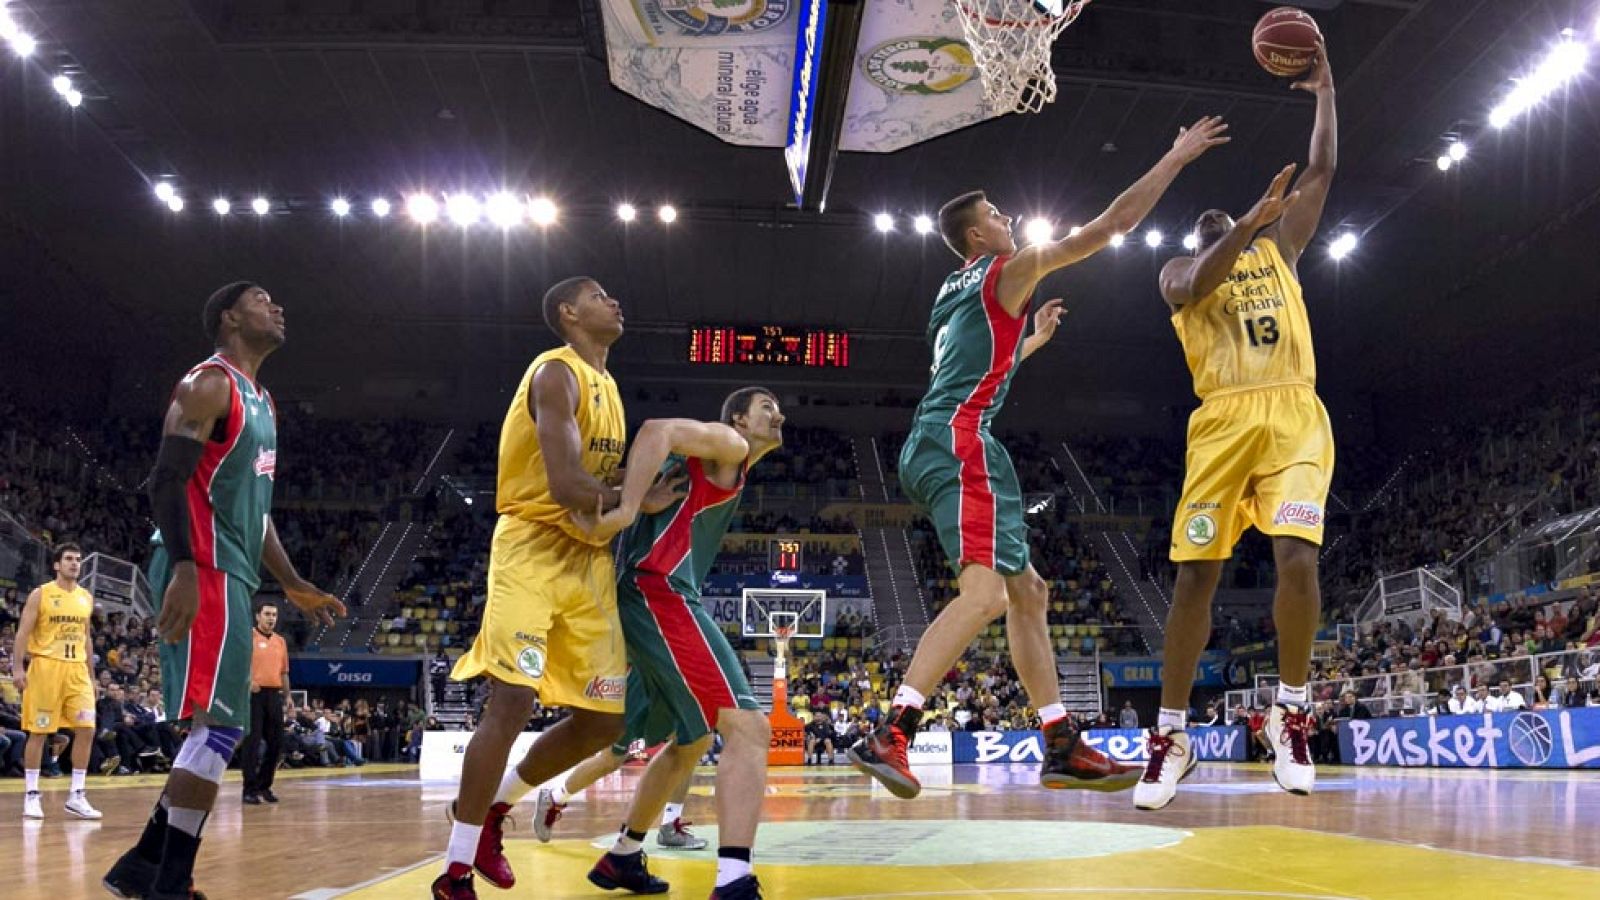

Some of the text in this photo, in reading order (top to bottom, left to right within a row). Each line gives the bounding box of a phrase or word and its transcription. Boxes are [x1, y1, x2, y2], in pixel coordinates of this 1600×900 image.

[717, 51, 739, 97] mineral
[739, 68, 767, 125] elige agua
[1244, 315, 1280, 347] 13
[781, 552, 797, 569] 11
[714, 600, 755, 622] AGUA
[64, 643, 76, 659] 11
[769, 738, 804, 748] ONE
[1349, 707, 1503, 767] Basket
